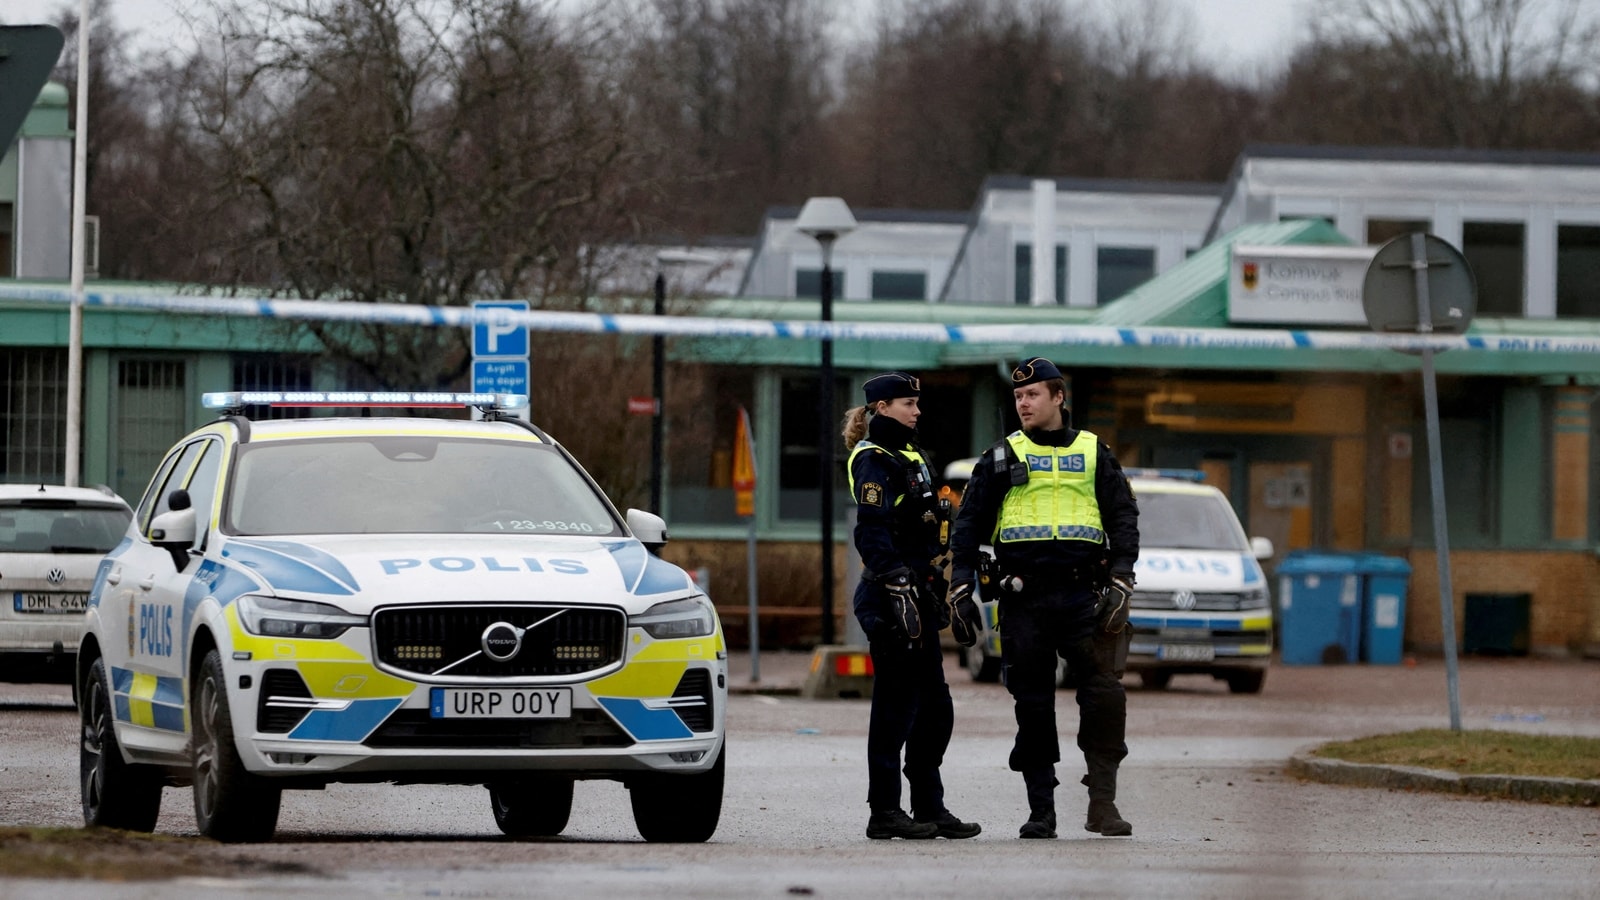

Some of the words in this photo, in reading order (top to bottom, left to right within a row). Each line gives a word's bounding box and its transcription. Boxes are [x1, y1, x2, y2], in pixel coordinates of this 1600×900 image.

[487, 307, 518, 353] P
[1028, 455, 1083, 470] POLIS
[864, 483, 881, 491] POLIS
[493, 520, 504, 530] 1
[510, 520, 593, 532] 23-9340
[379, 557, 589, 575] POLIS
[1135, 556, 1230, 576] OLIS
[27, 594, 52, 608] DML
[141, 604, 172, 657] POLIS
[454, 692, 502, 714] URP
